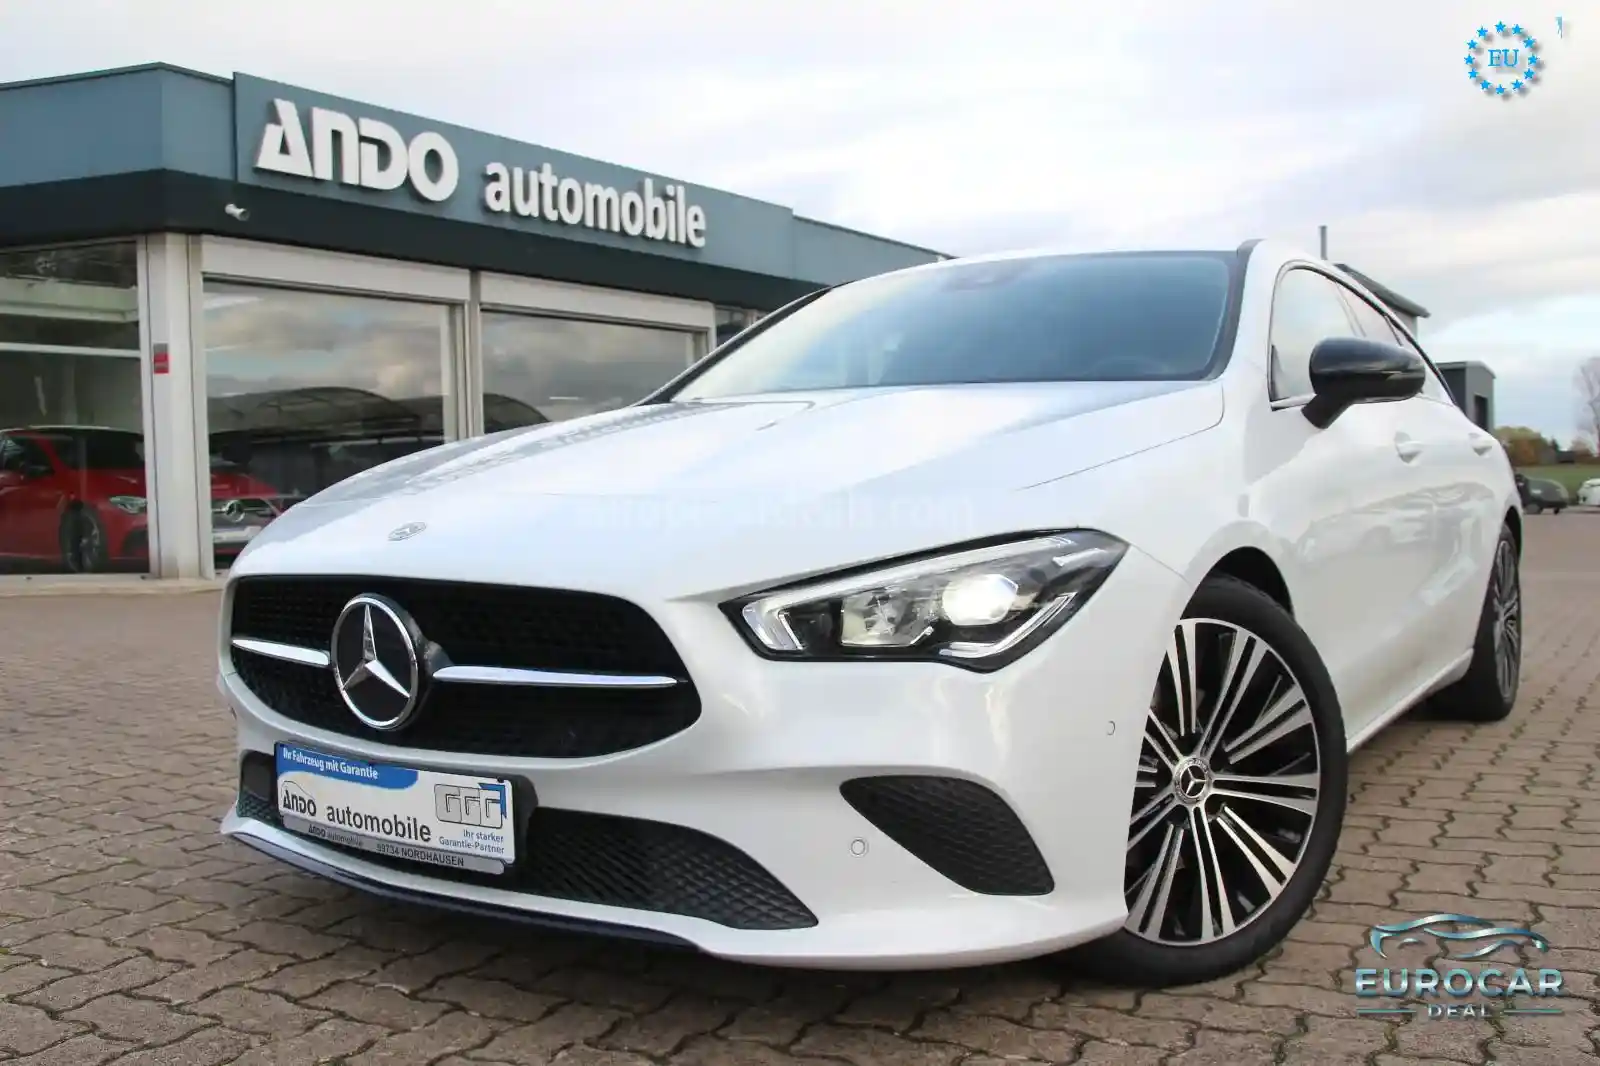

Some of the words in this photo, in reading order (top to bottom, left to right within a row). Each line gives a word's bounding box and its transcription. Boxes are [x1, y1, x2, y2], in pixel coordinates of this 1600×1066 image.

[484, 162, 706, 248] automobile
[283, 747, 292, 759] Ihr
[292, 750, 325, 771] Fahrzeug
[325, 759, 339, 772] mit
[340, 761, 379, 779] Garantie
[326, 805, 432, 842] automobile
[463, 829, 475, 838] Ihr
[475, 830, 504, 843] starker
[401, 846, 464, 867] NORDHAUSEN
[439, 836, 505, 855] Garantie-Partner
